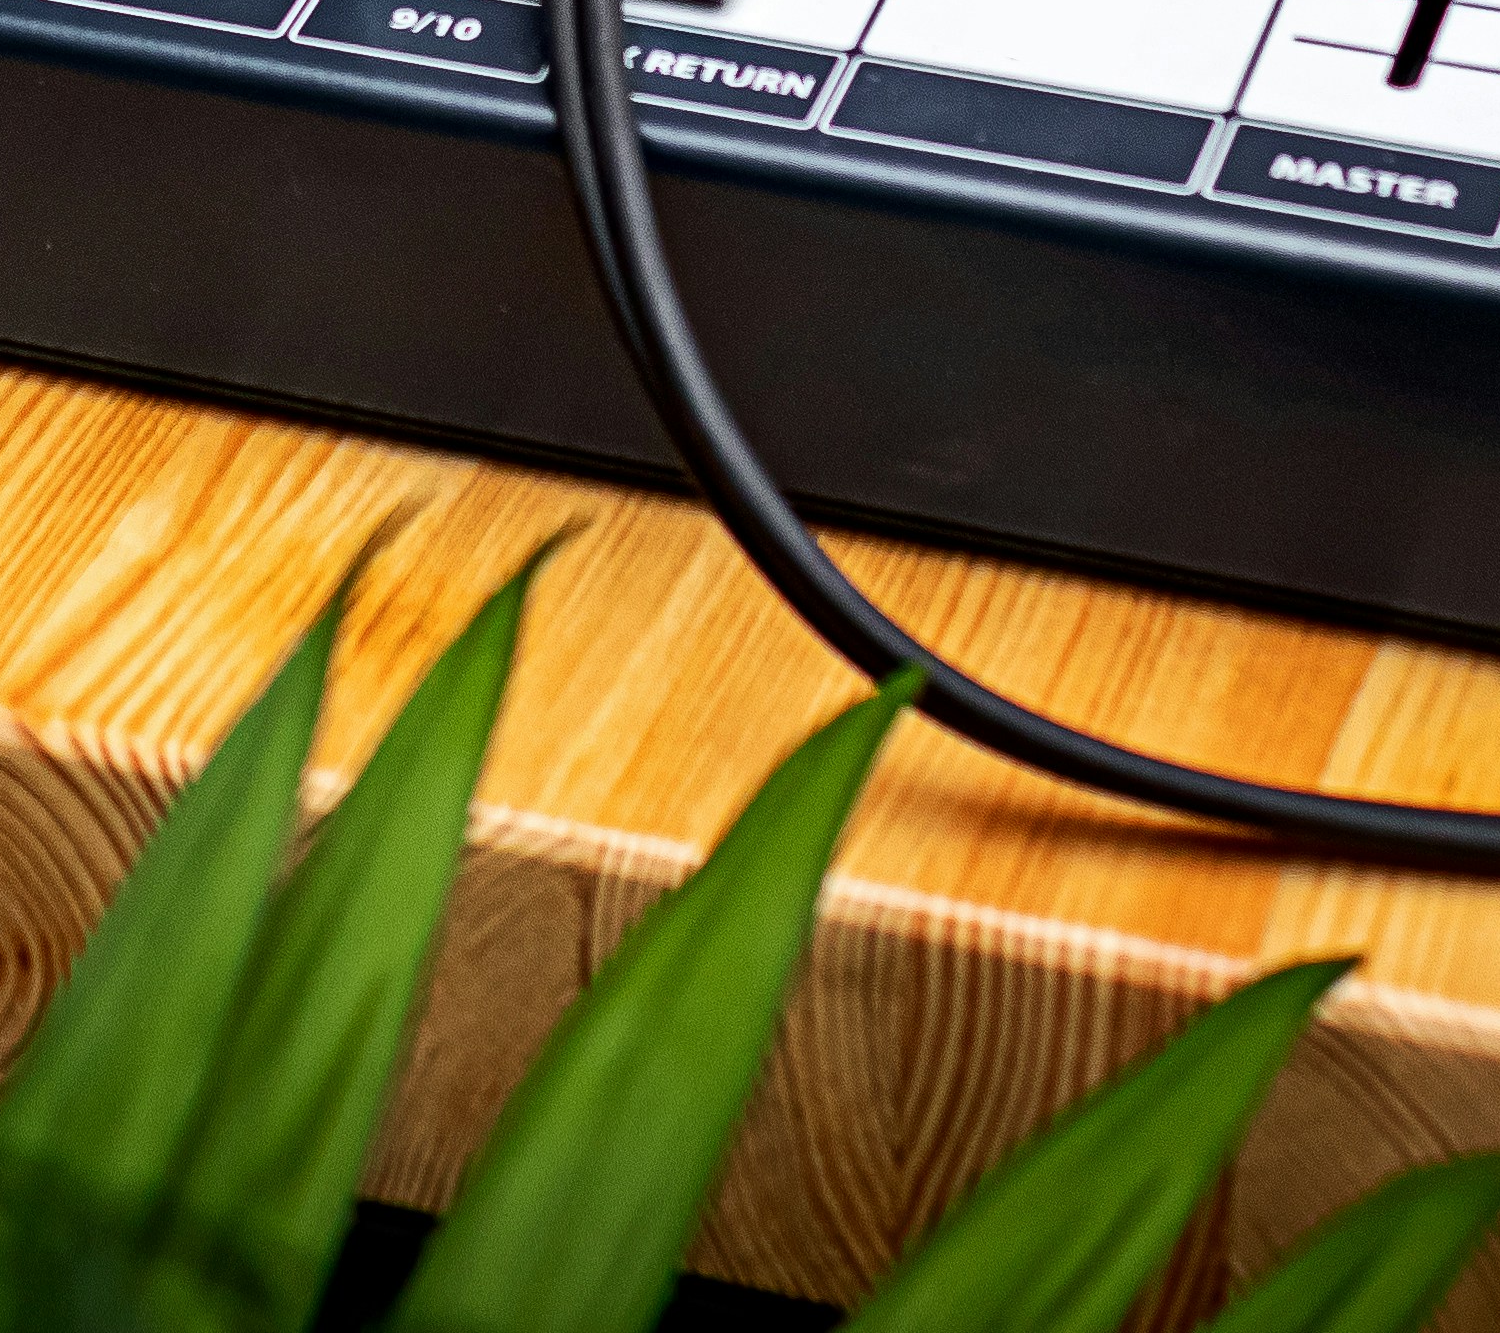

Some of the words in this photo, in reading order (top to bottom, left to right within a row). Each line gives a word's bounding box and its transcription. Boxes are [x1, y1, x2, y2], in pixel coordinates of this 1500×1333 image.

[387, 6, 483, 44] 9/10
[643, 47, 818, 102] RETURN
[1267, 152, 1461, 211] MASTER
